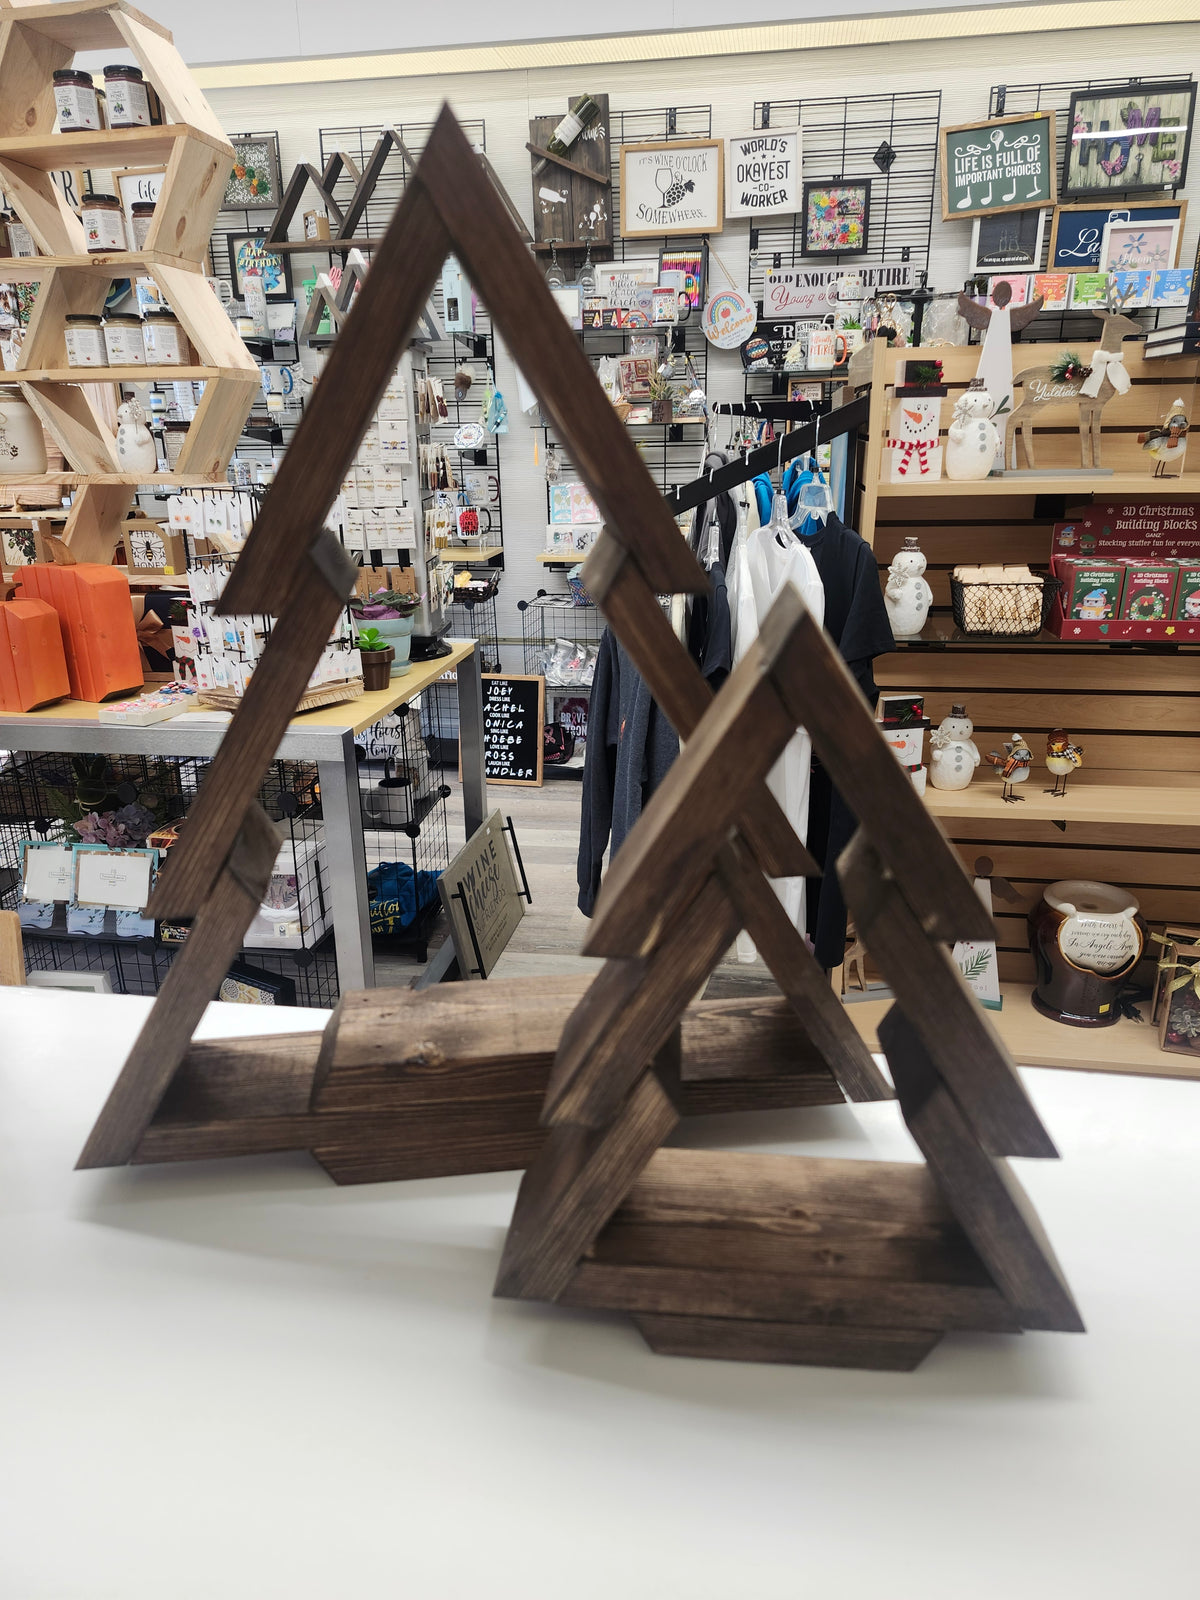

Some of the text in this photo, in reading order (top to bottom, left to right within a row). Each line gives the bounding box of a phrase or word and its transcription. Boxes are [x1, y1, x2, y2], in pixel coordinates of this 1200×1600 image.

[740, 138, 788, 157] WORLD'S
[1079, 107, 1181, 177] HOME
[655, 153, 674, 168] WINE
[676, 152, 708, 173] O'CLOCK
[954, 145, 1041, 174] LIFE IS FULL OF
[736, 160, 791, 183] OKAYEST
[954, 162, 1041, 188] IMPORTANT CHOICES
[740, 189, 788, 208] WORKER
[240, 256, 282, 268] BIRTHDAY
[769, 273, 793, 284] OLD
[859, 267, 911, 288] RETIRE
[770, 285, 815, 312] Young
[706, 313, 755, 341] Welcome
[810, 344, 834, 357] RETIRED
[1029, 379, 1080, 402] Yuletide
[1122, 505, 1195, 516] 3D Christmas
[1115, 519, 1198, 531] Building Blocks
[1098, 540, 1127, 548] Stocking
[1176, 540, 1200, 548] everyo
[487, 686, 513, 695] JOEY
[483, 703, 525, 713] ACHEL
[485, 719, 524, 729] ONICA
[483, 734, 522, 744] HOEBE
[484, 751, 515, 761] ROSS
[485, 767, 533, 778] ANDLER
[463, 839, 497, 893] WINE
